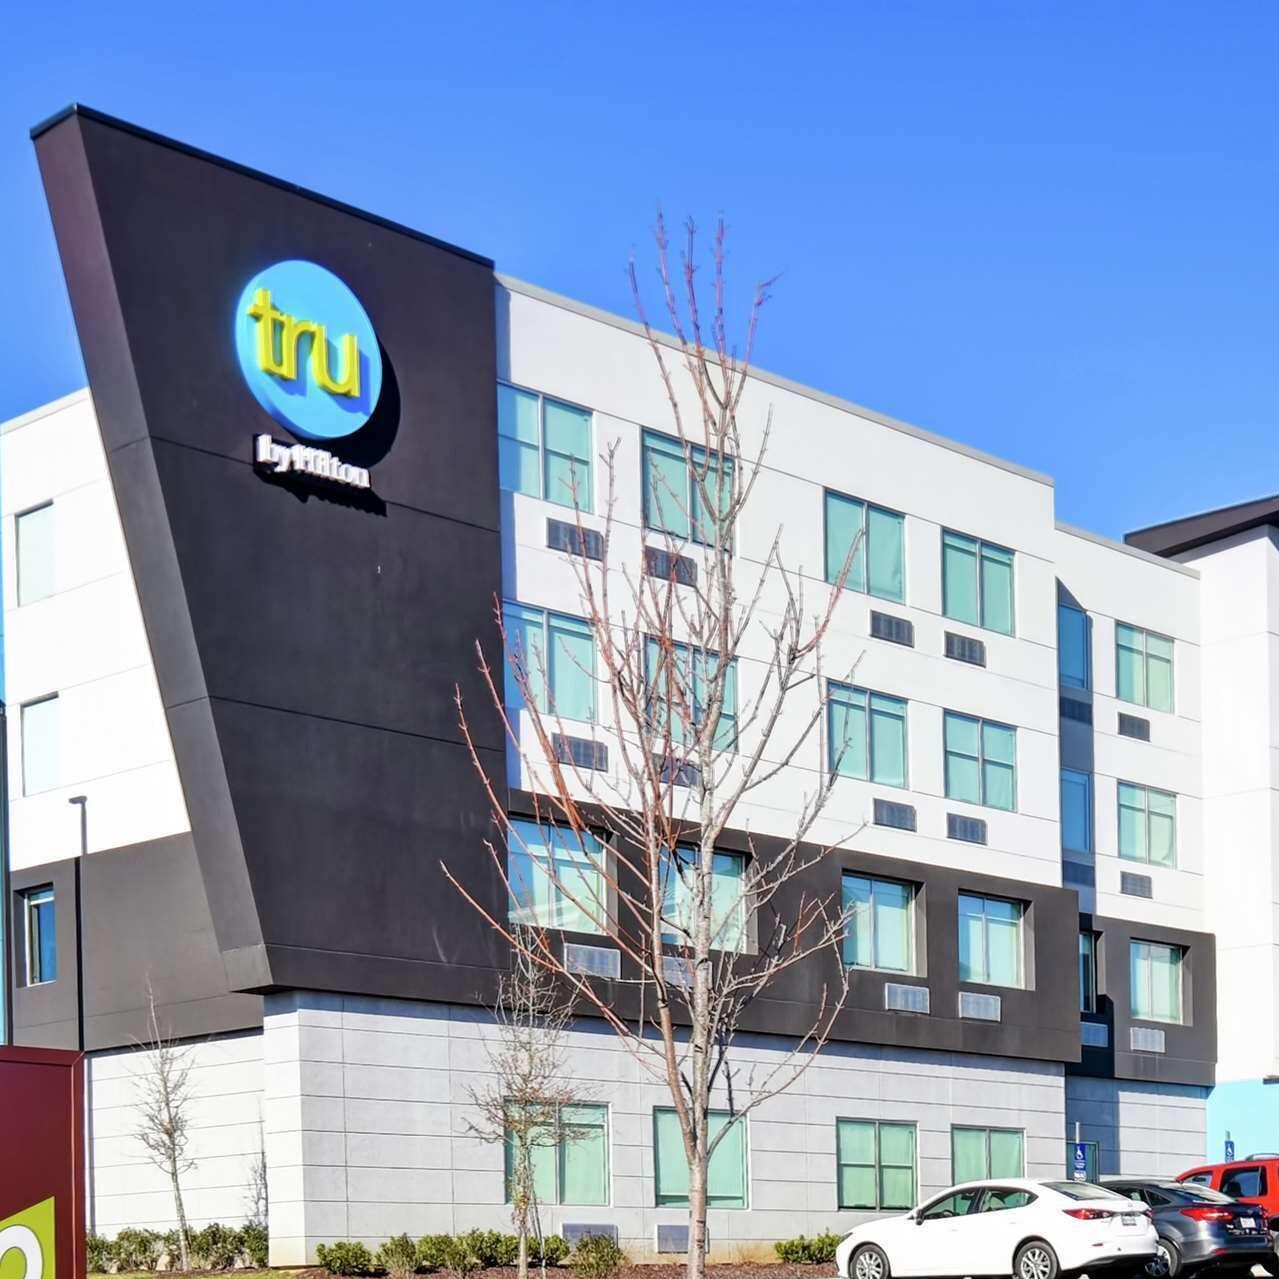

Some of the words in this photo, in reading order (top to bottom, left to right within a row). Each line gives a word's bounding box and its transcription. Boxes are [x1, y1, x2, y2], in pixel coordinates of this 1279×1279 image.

[248, 289, 361, 398] tru
[256, 433, 292, 473] by
[290, 443, 371, 489] Hilton
